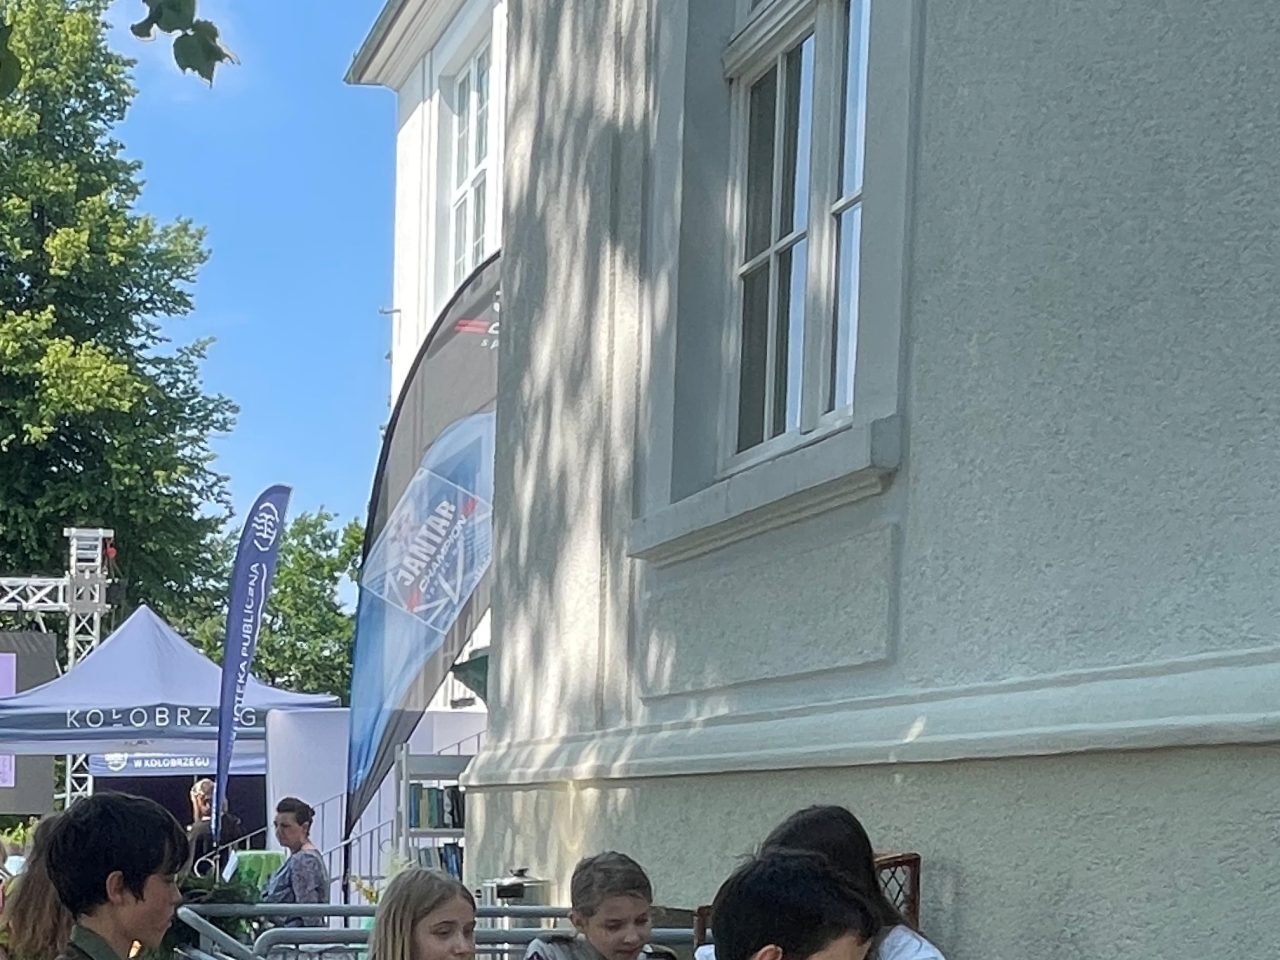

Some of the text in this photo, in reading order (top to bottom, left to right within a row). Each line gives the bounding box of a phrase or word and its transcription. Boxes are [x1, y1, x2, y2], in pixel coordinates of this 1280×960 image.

[397, 500, 456, 586] JANTAR
[419, 514, 467, 593] CHAMPION
[241, 563, 260, 657] PUBLICZNA
[66, 707, 257, 728] KOŁOBRZG
[133, 759, 143, 768] W
